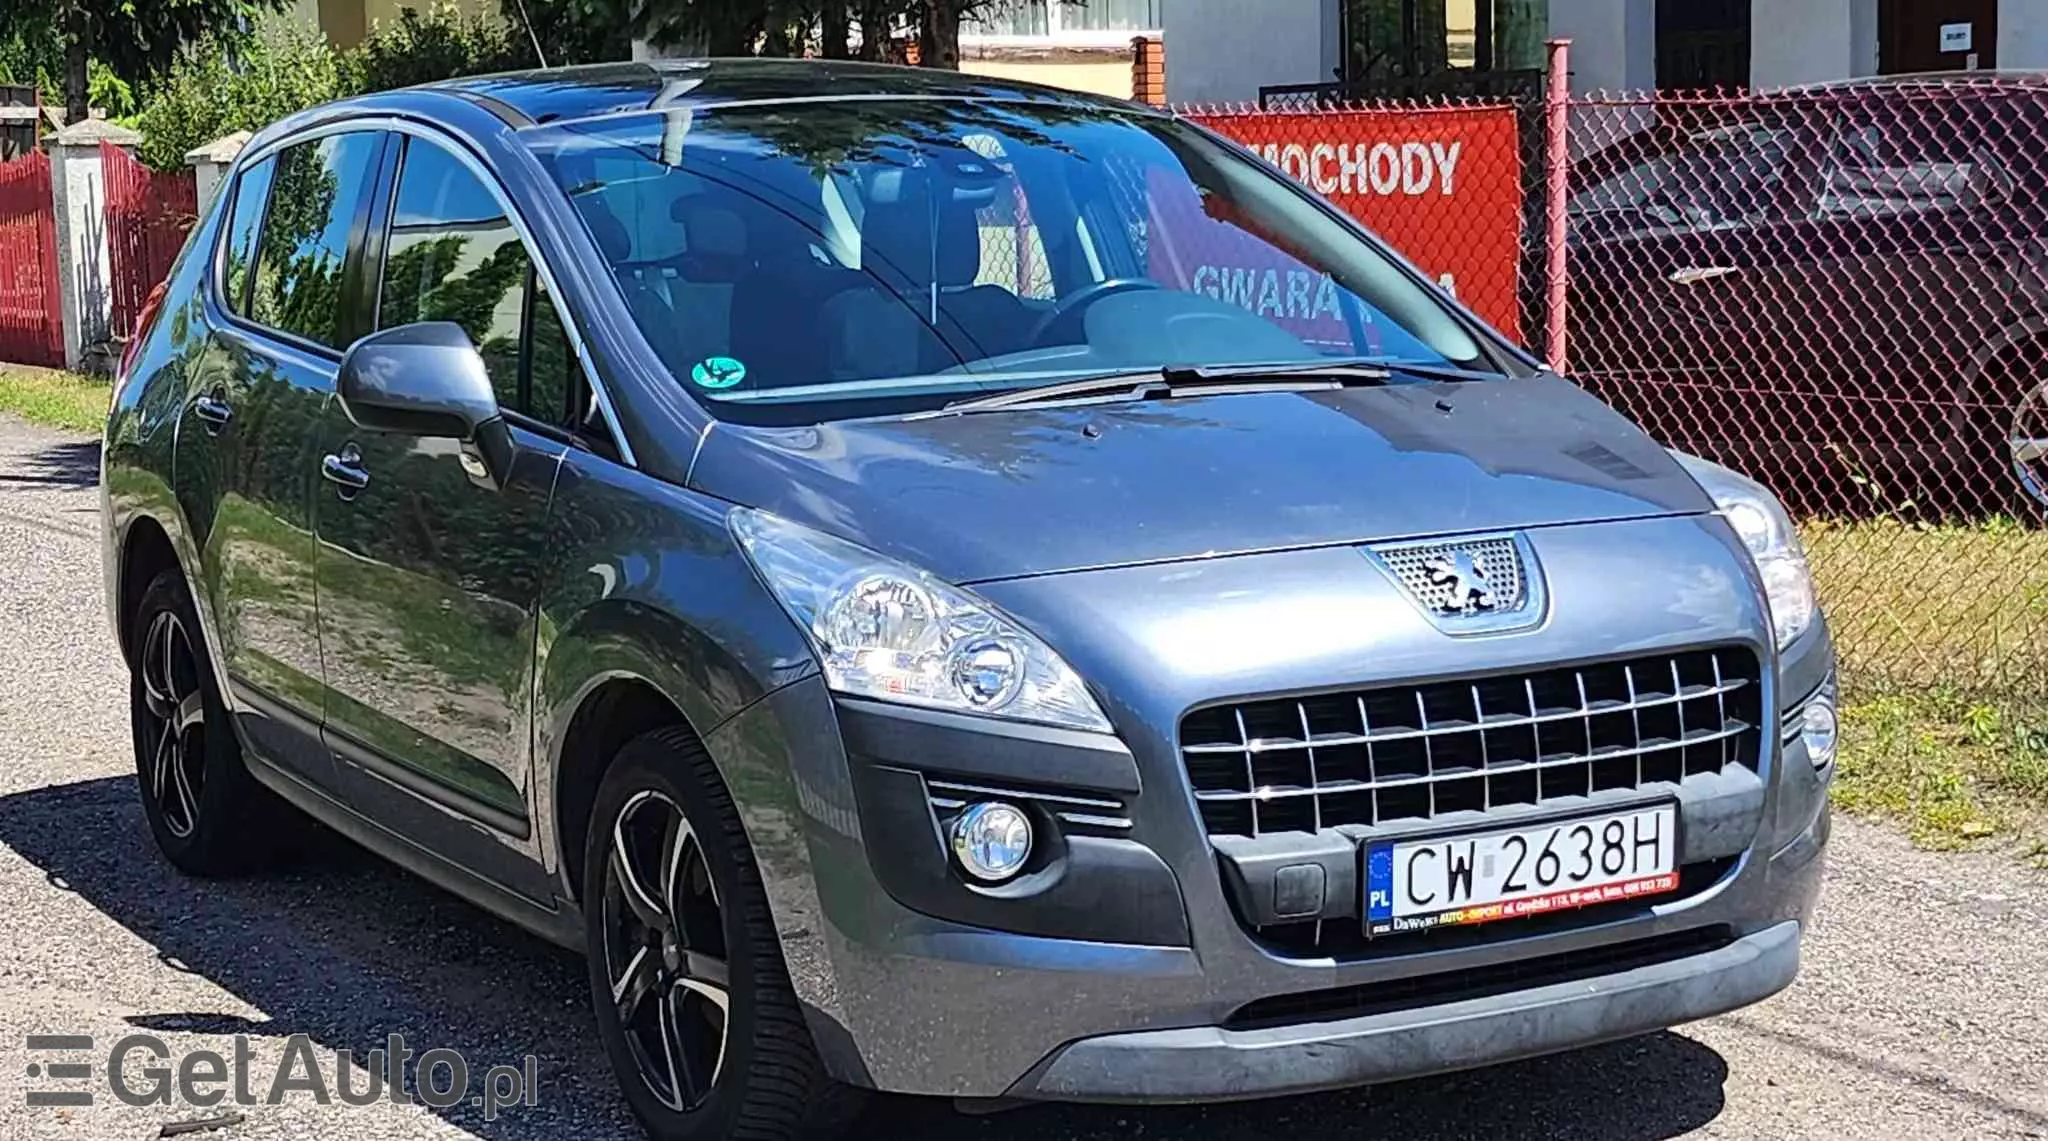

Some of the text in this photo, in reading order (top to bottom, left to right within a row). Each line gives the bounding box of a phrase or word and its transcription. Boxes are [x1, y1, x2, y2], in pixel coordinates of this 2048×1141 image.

[1407, 812, 1661, 906] CW 2638H
[1370, 890, 1389, 908] PL
